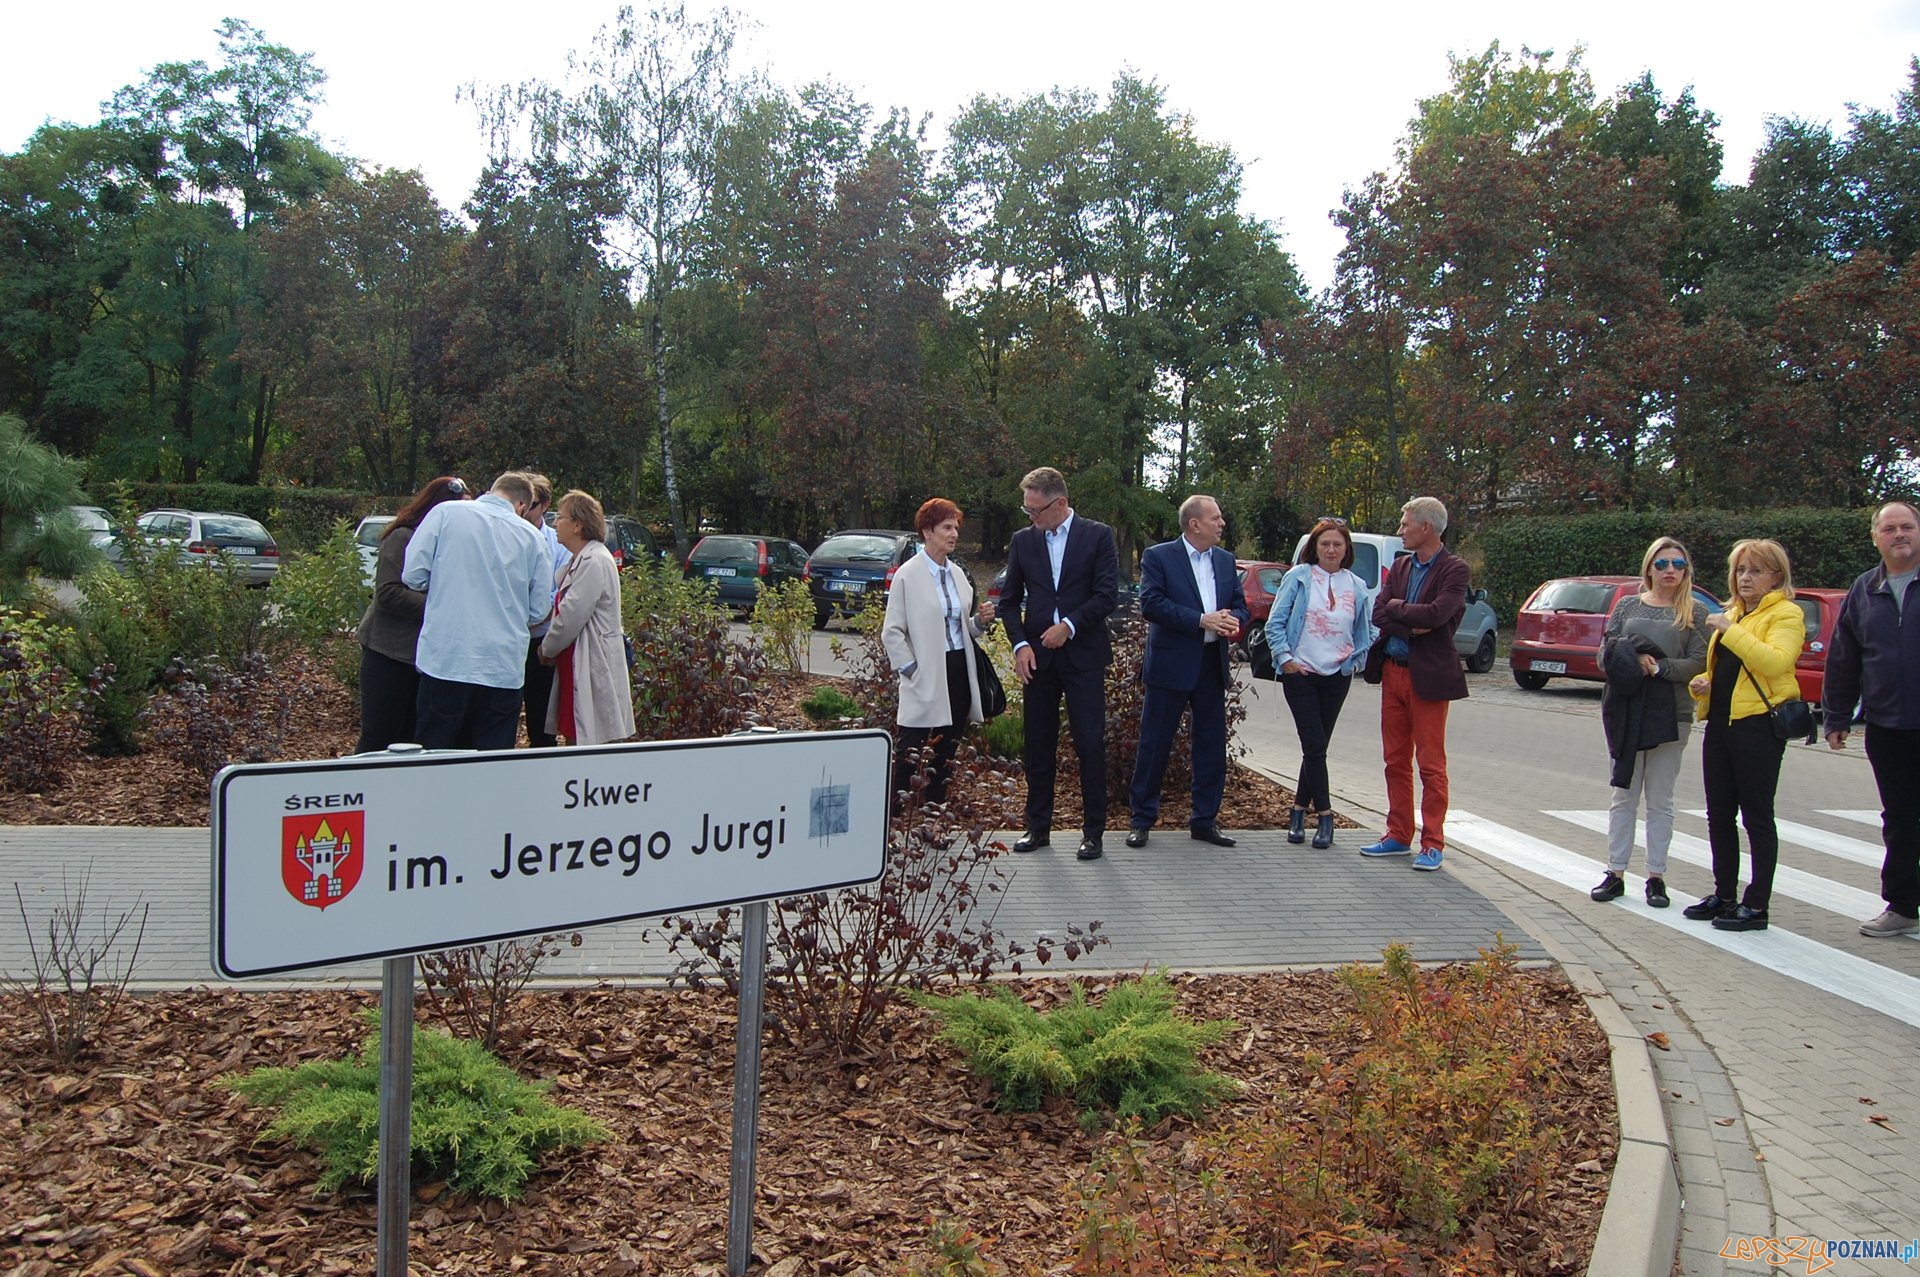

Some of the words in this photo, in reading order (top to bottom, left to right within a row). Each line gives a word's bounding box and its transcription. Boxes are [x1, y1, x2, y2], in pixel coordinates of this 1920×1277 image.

[284, 792, 364, 811] ŚREM
[564, 778, 653, 810] Skwer
[388, 843, 464, 892] im.
[490, 830, 672, 880] Jerzego
[691, 805, 787, 860] Jurgi
